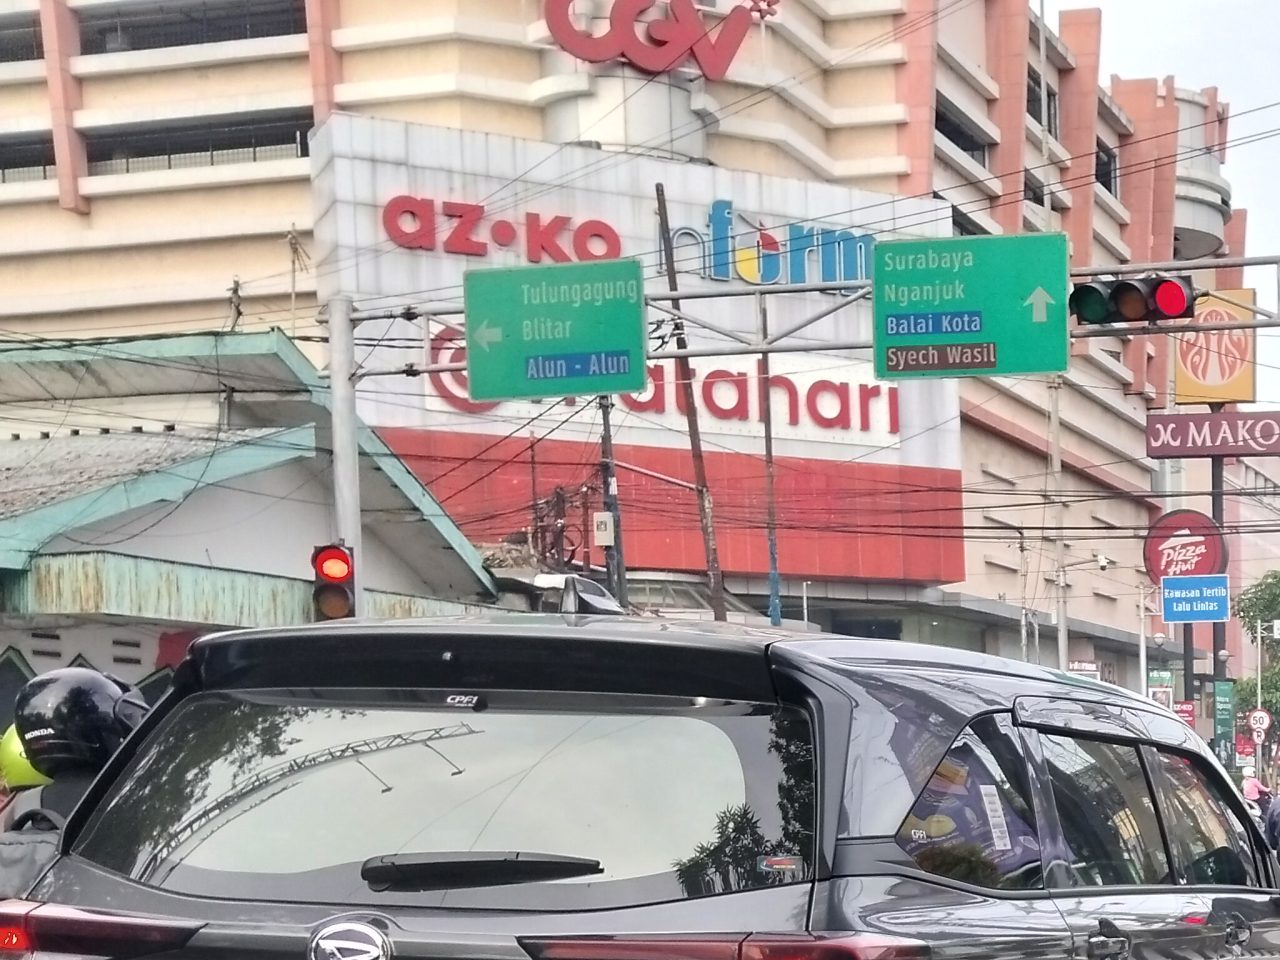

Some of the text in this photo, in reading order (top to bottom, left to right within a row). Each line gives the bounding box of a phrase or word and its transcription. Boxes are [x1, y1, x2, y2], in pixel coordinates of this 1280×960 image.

[884, 249, 974, 272] Surabaya
[521, 281, 638, 308] Tulungagung
[884, 284, 965, 307] Nganjuk
[522, 319, 572, 341] Blitar
[887, 314, 981, 334] Balai Kota
[527, 357, 567, 379] Alun
[589, 354, 630, 376] Alun
[887, 343, 996, 370] Syech Wasil
[528, 350, 899, 434] atahari
[1187, 420, 1280, 450] MAKO
[1161, 545, 1207, 570] Pizza
[1167, 557, 1202, 576] Hut
[1164, 587, 1226, 598] Kawasan Tertib
[1173, 601, 1218, 611] Lalu Lintas
[1252, 716, 1265, 726] 50
[24, 727, 55, 740] HONDA
